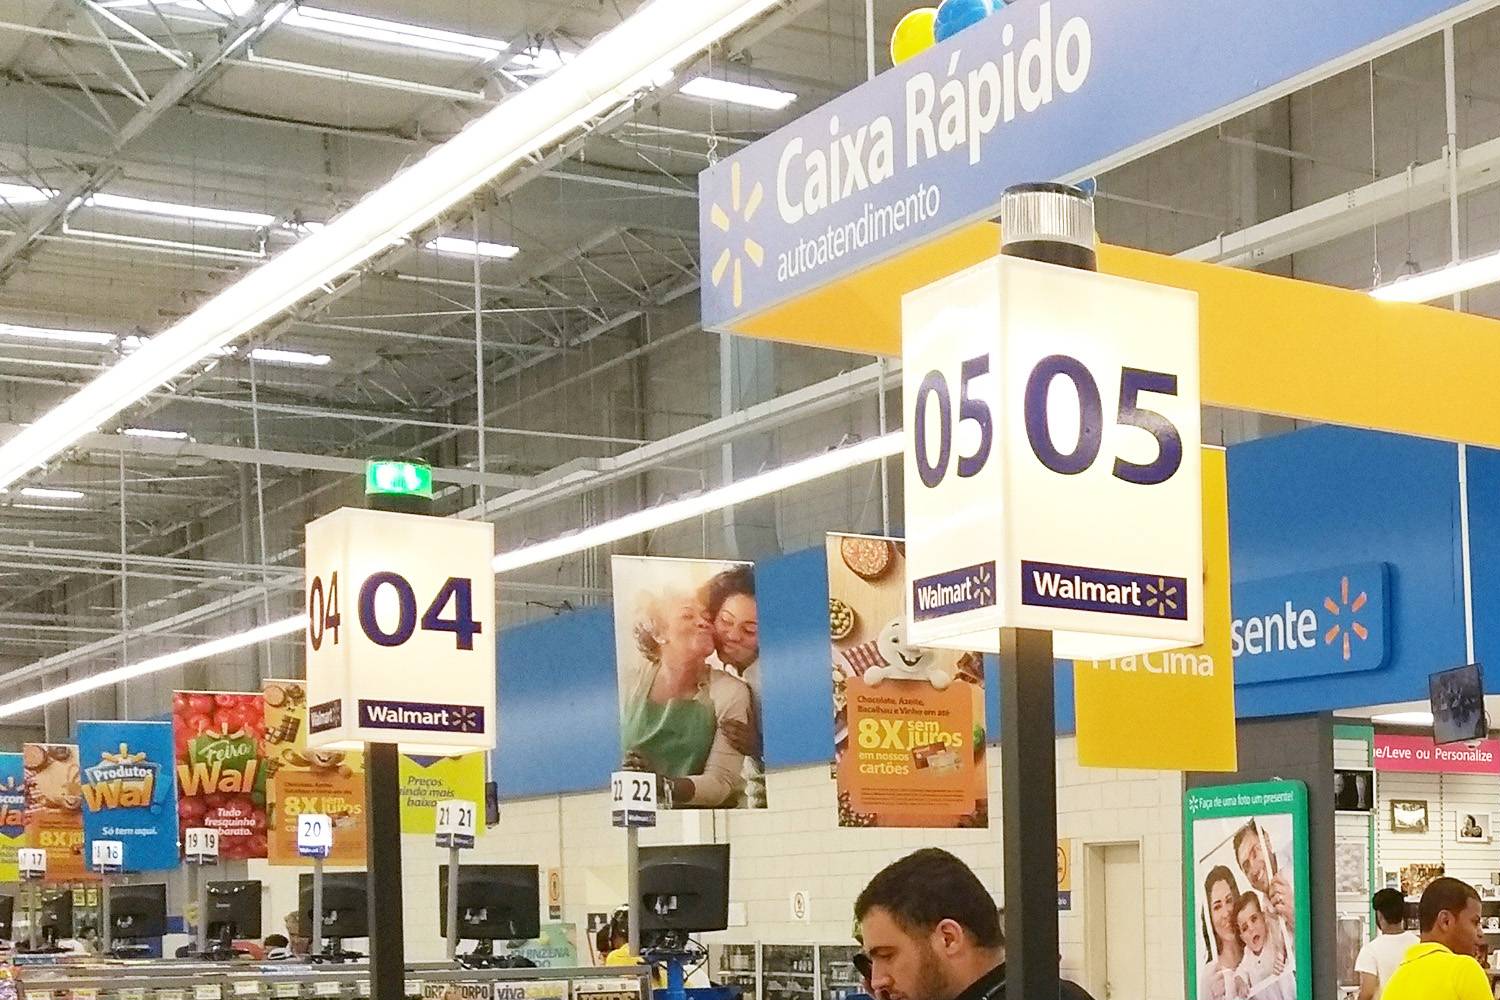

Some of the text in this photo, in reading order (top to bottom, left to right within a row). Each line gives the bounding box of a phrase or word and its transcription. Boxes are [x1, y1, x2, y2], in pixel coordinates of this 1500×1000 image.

[776, 4, 1092, 225] Caixa Rápido
[777, 183, 940, 283] autoatendimento
[914, 351, 993, 489] 05
[1023, 354, 1184, 486] 05
[917, 576, 972, 612] Walmart
[1032, 570, 1142, 608] Walmart
[309, 570, 341, 651] 04
[358, 571, 482, 651] 04
[1232, 601, 1317, 657] sente
[367, 705, 449, 726] Walmart
[858, 718, 939, 750] 8X sem
[907, 730, 963, 751] juros
[877, 751, 909, 761] nossos
[1416, 749, 1430, 759] ou
[1435, 747, 1493, 762] Personalize
[93, 763, 153, 783] Produtos
[859, 761, 910, 775] cartões
[407, 775, 442, 789] Preços
[632, 780, 651, 801] 22
[406, 796, 438, 807] baixo
[217, 807, 241, 817] Tudo
[440, 806, 450, 826] 21
[458, 808, 472, 828] 21
[204, 817, 256, 828] fresquinho
[304, 821, 321, 838] 20
[188, 833, 198, 848] 19
[204, 834, 215, 848] 19
[32, 853, 42, 866] 17
[461, 985, 489, 999] ORPO
